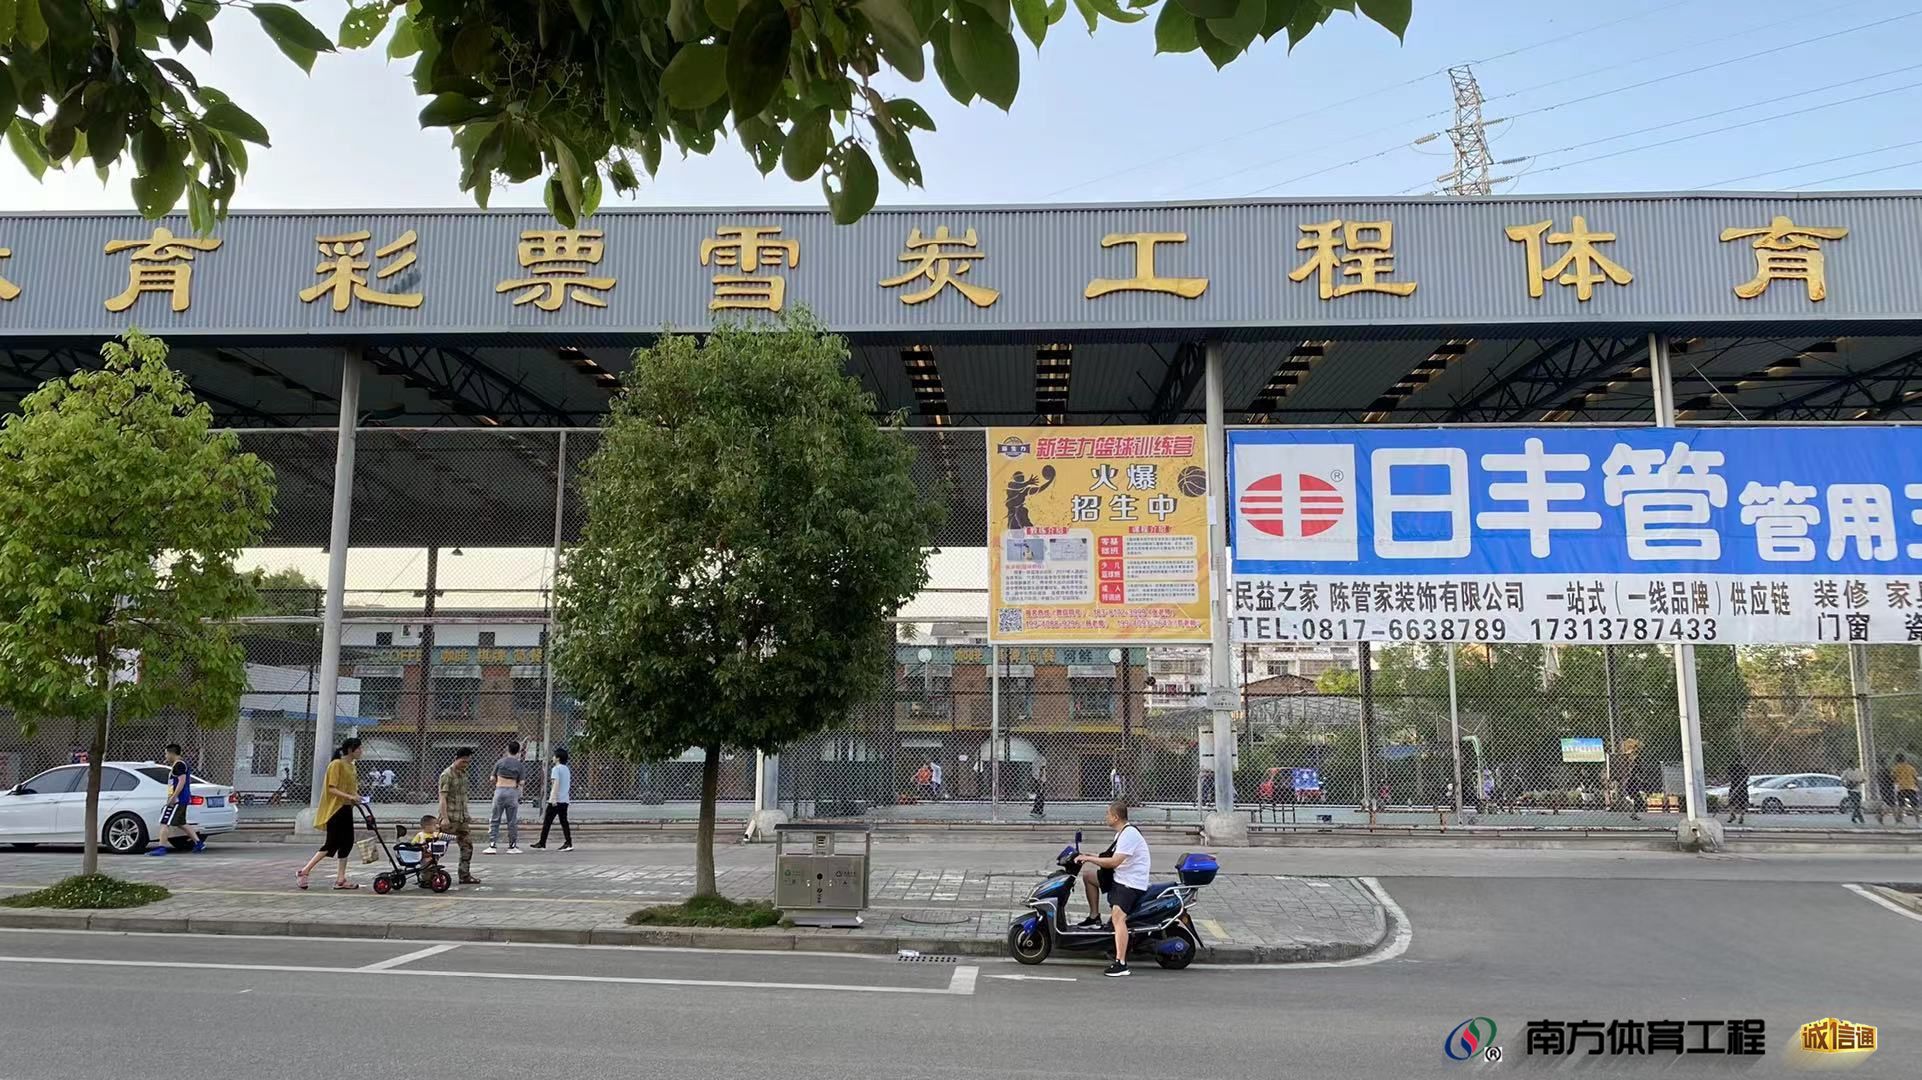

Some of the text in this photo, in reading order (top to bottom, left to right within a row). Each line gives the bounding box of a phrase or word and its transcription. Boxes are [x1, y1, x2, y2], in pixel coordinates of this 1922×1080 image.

[0, 215, 1848, 313] 育彩票雪炭工程体育
[1036, 436, 1195, 459] 新生力篮球训练营
[1090, 464, 1158, 492] 火爆
[1071, 494, 1177, 522] 招生中
[1371, 437, 1727, 561] 日丰管
[1235, 581, 1319, 612] 民益之家
[1330, 581, 1524, 613] 陈管家装饰有限公司
[1814, 579, 1869, 609] 装修
[1238, 616, 1717, 641] TEL:0817-6638789 17313787433
[1817, 612, 1870, 642] 门窗
